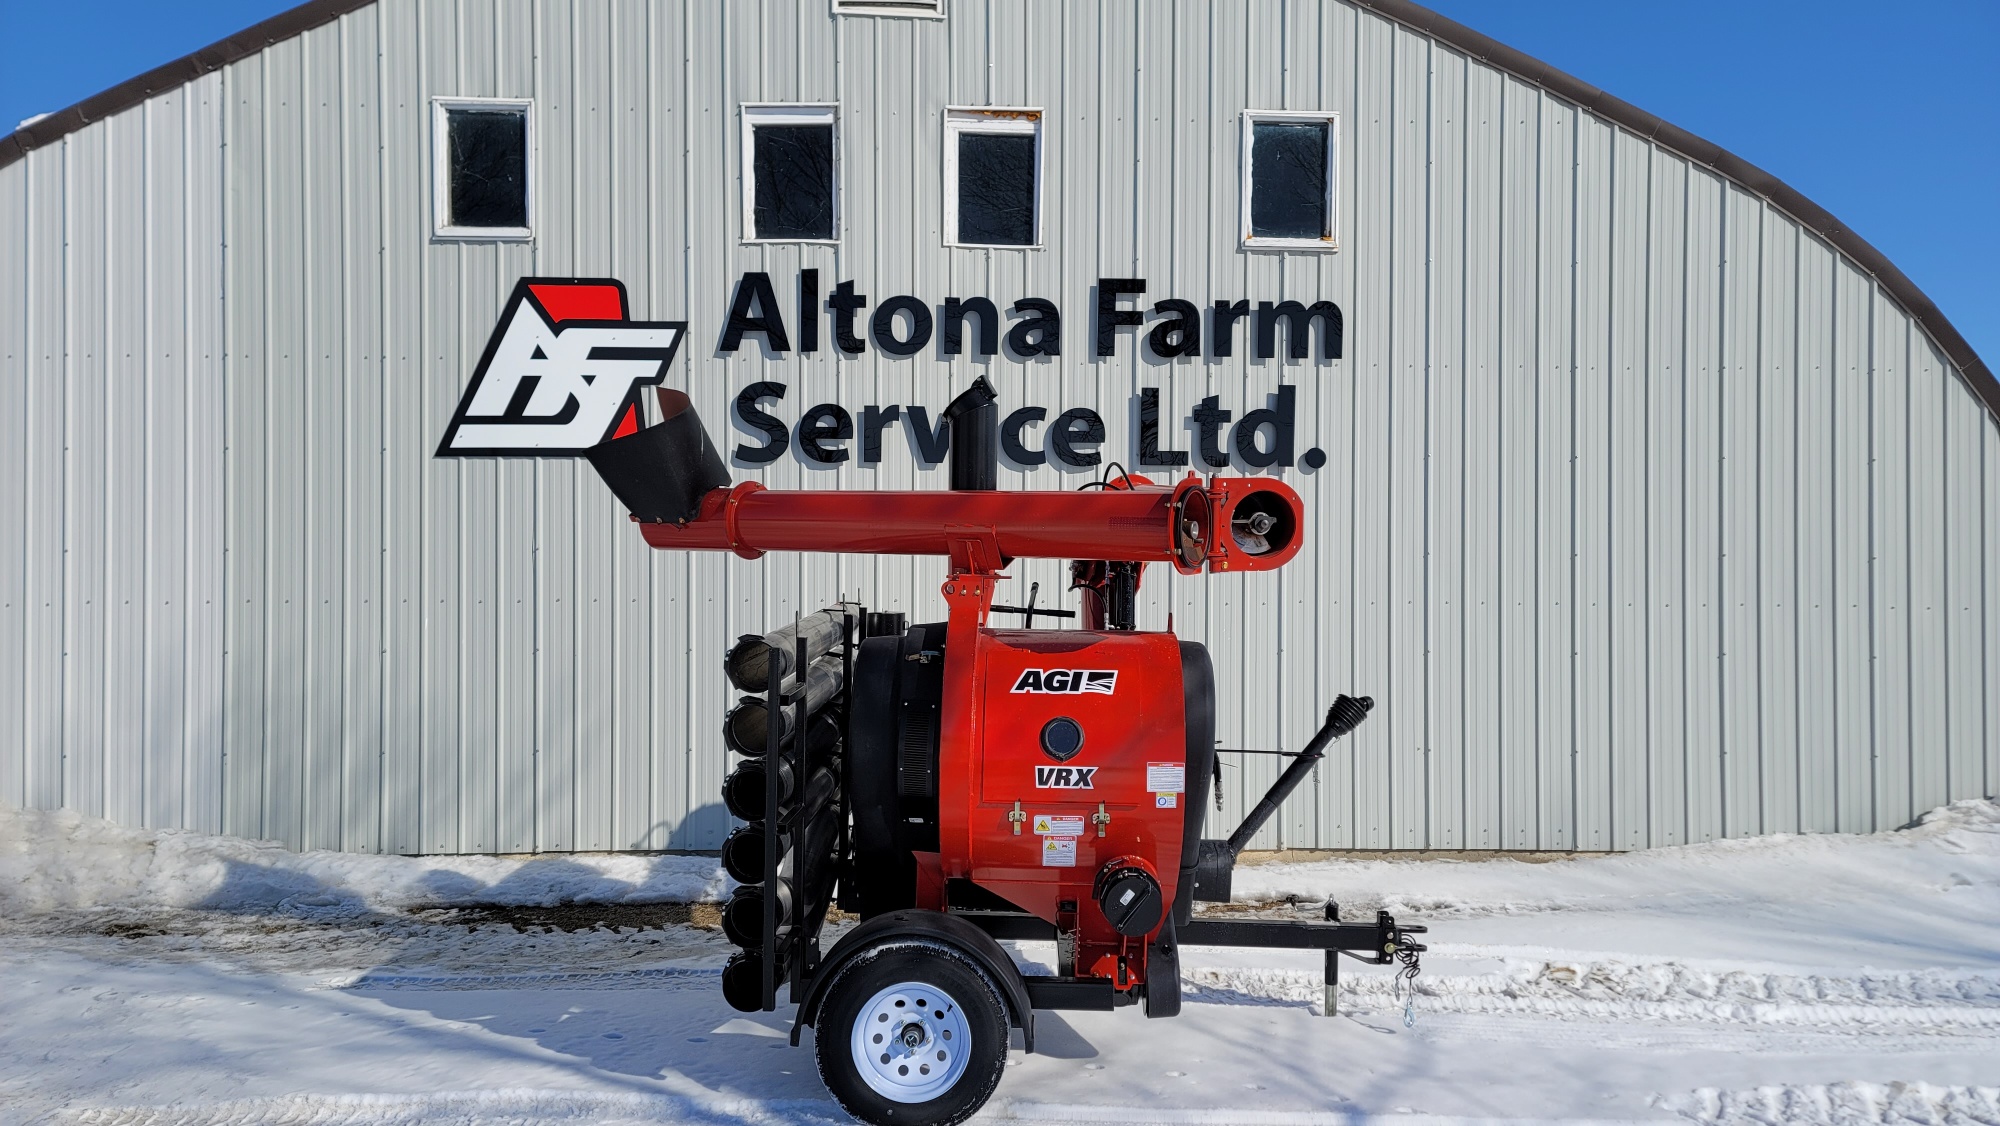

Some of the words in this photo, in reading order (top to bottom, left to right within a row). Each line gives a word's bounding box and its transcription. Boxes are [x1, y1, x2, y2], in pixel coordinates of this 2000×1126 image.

[719, 268, 1060, 357] Altona
[1097, 278, 1343, 359] Farm
[735, 381, 1106, 467] Servce
[1140, 384, 1327, 469] Ltd.
[1014, 670, 1084, 692] AGI
[1037, 768, 1094, 787] VRX
